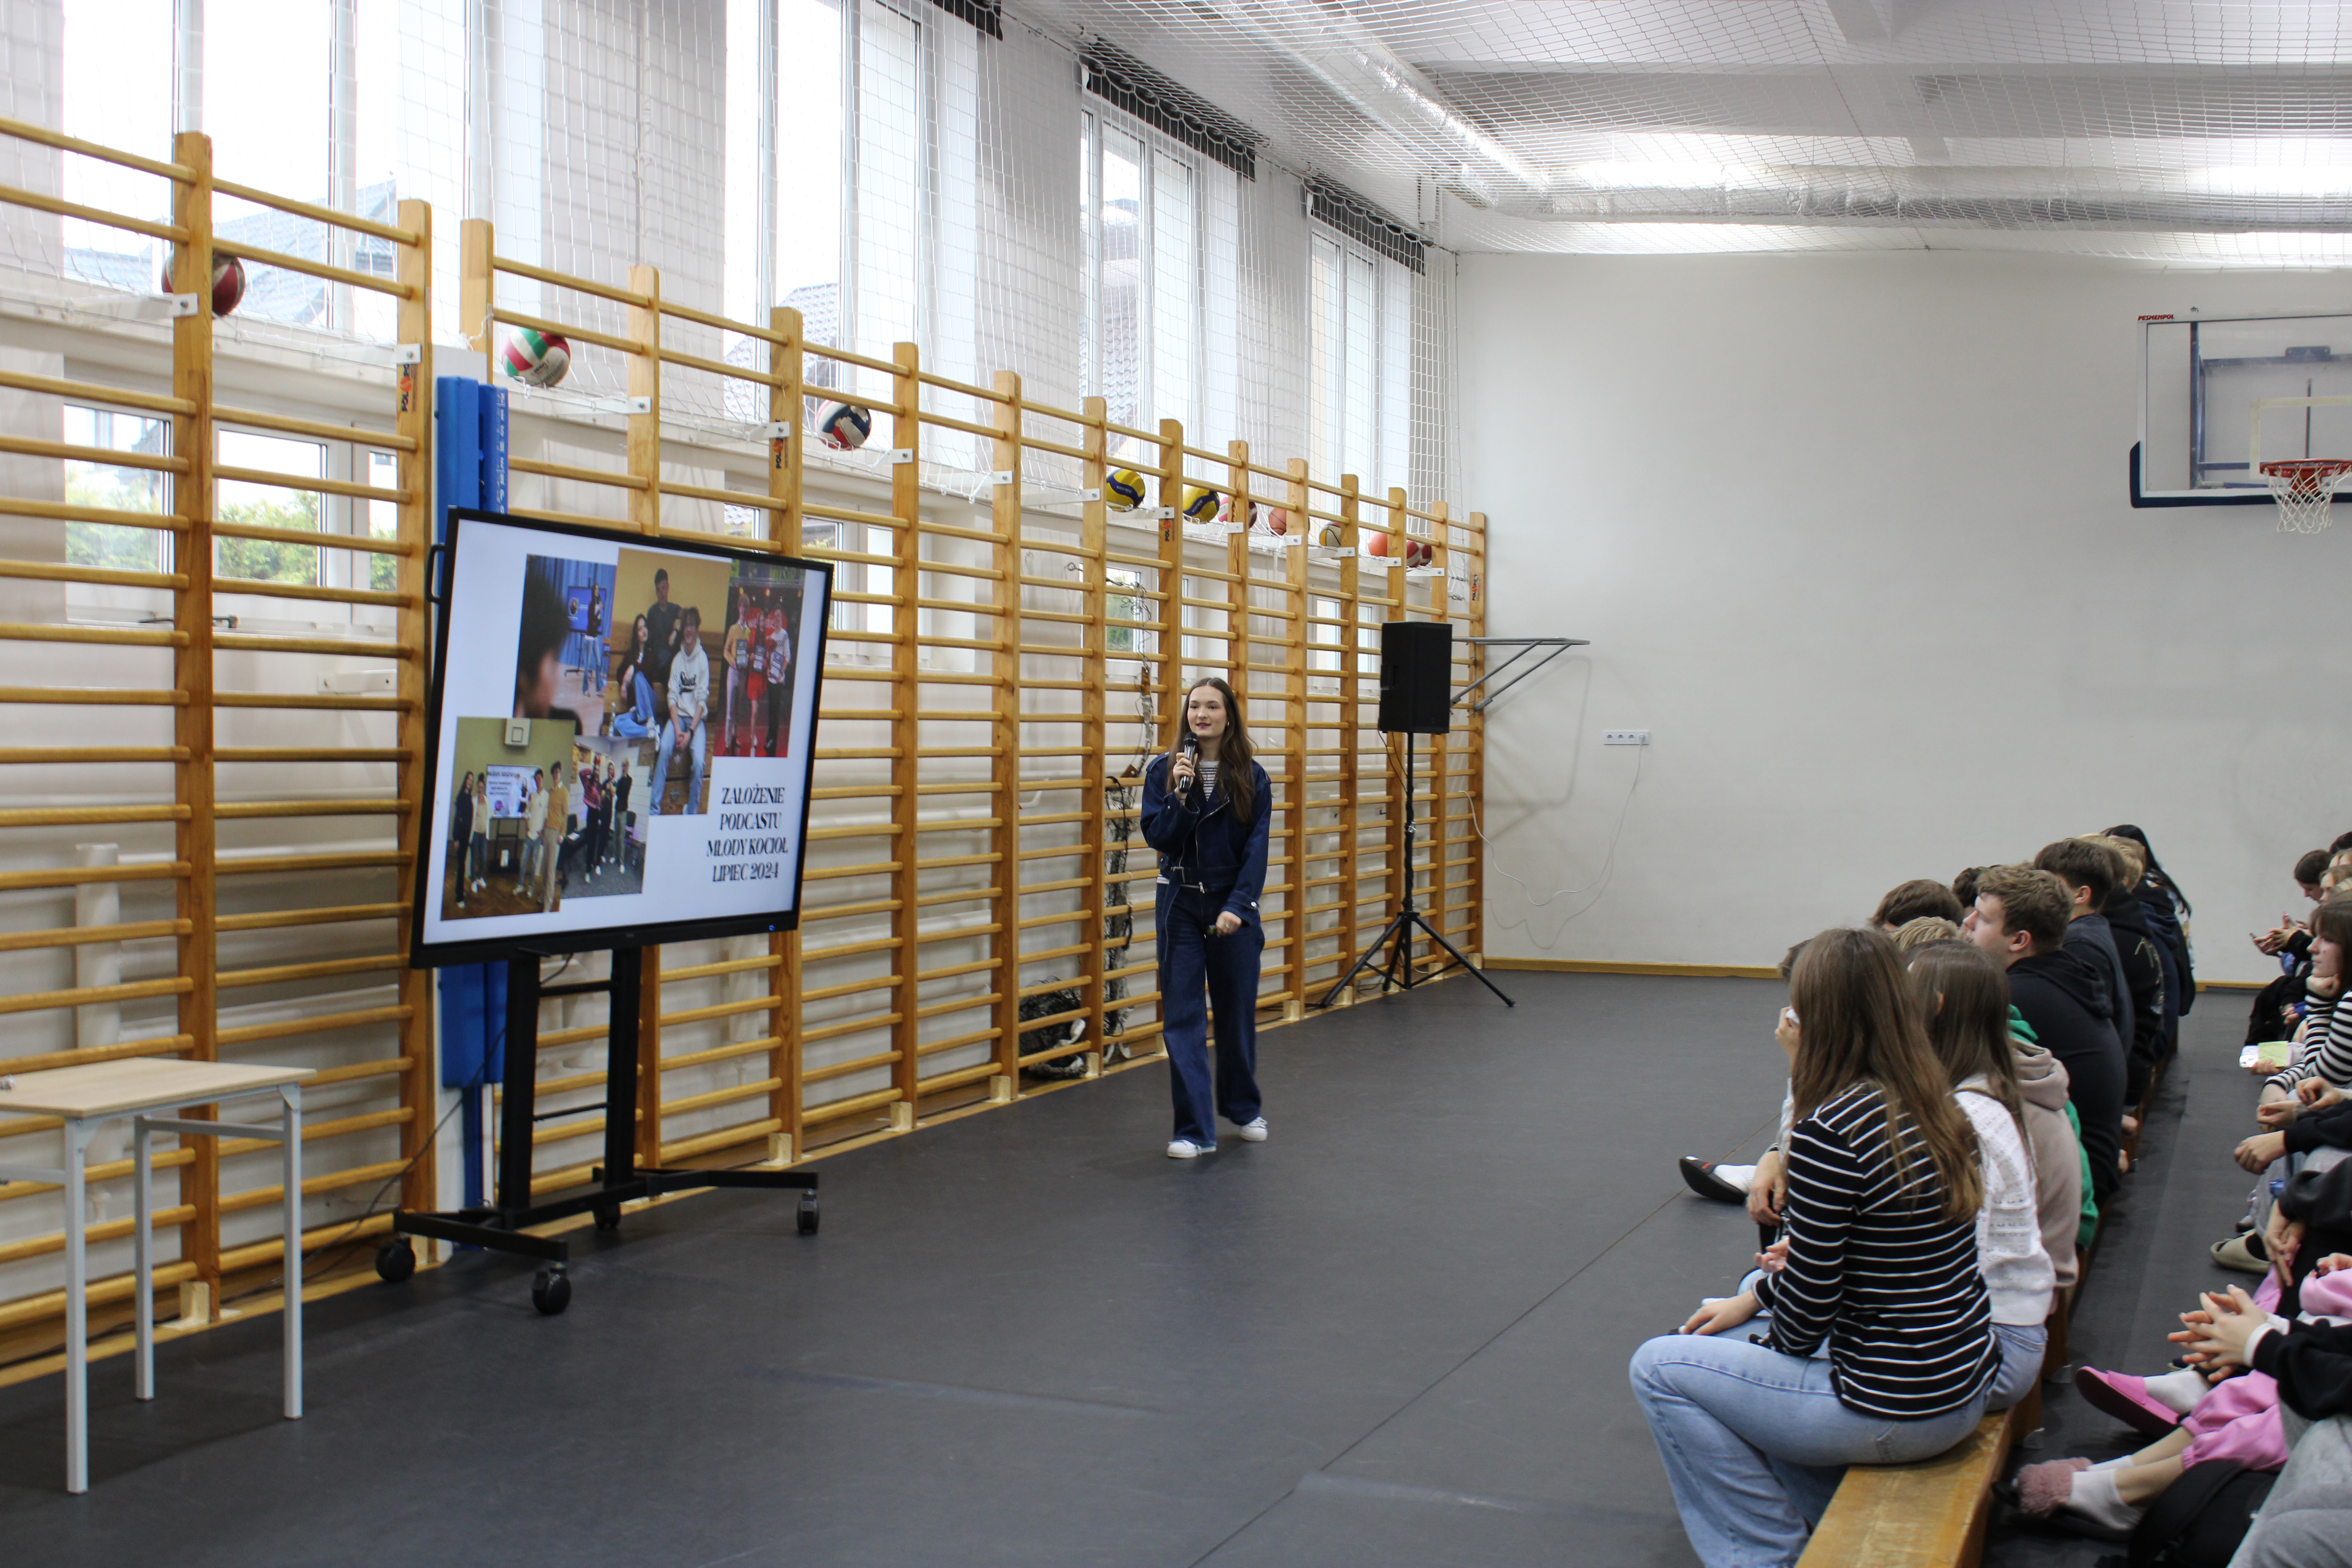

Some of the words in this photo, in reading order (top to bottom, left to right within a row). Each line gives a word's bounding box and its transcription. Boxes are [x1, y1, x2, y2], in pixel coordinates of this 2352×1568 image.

[720, 811, 782, 831] PODCASTU
[712, 863, 748, 882] LIPIEC
[750, 861, 779, 880] 2024
